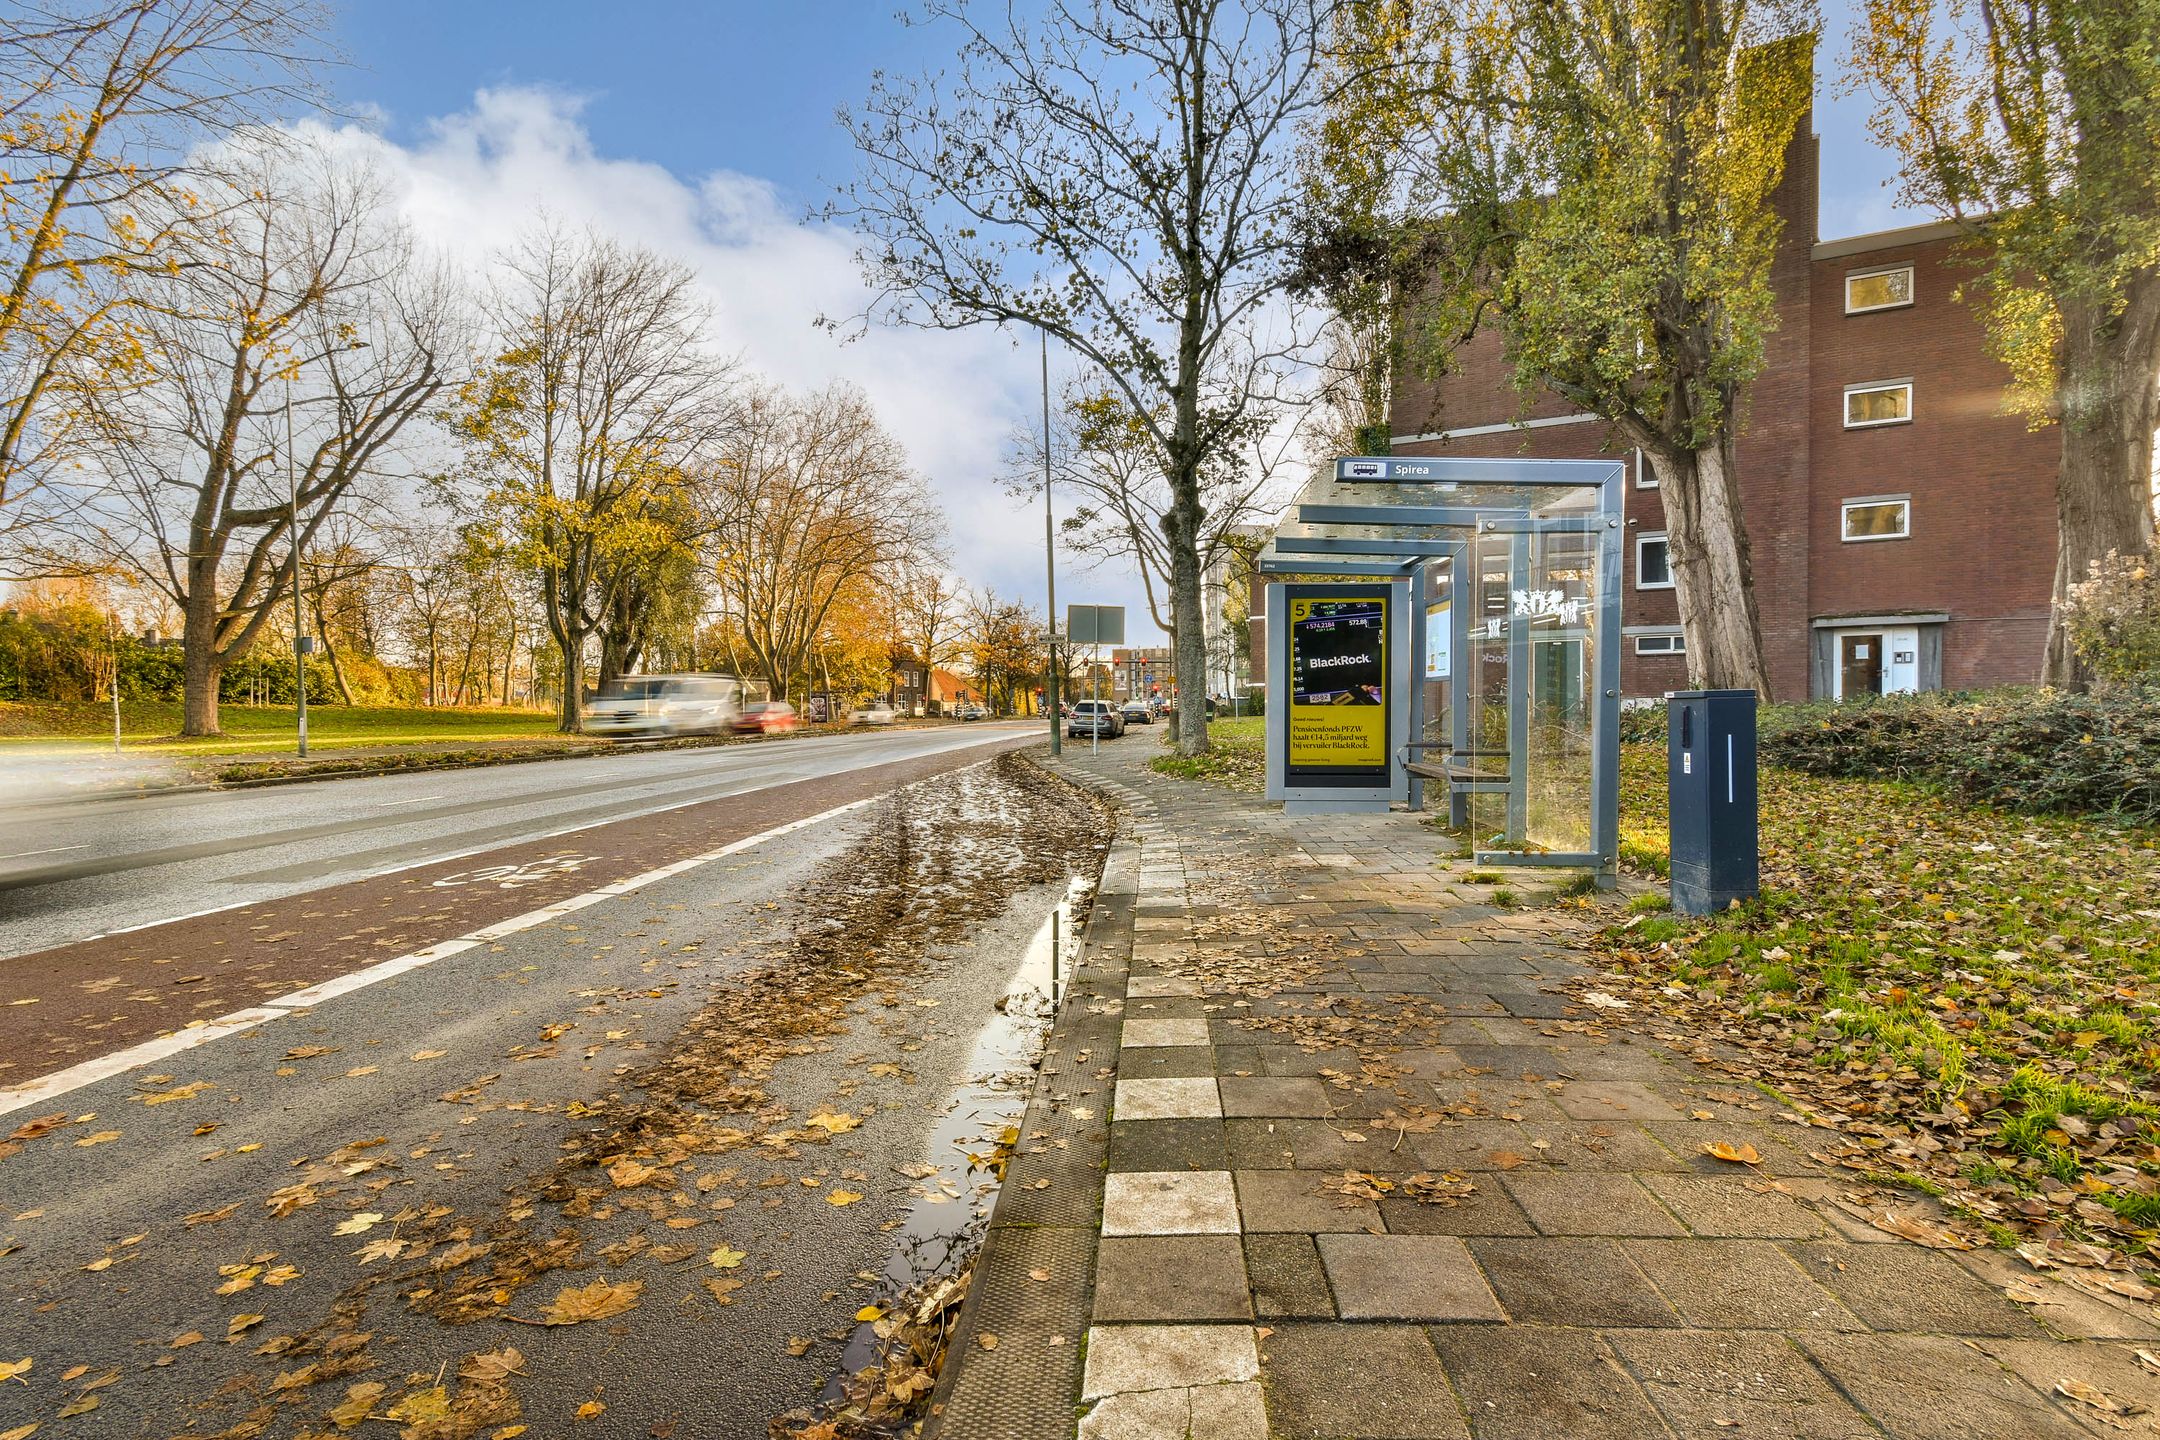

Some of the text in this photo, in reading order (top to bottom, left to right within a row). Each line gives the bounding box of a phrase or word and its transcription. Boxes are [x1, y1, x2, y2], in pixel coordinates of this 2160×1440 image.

[1395, 465, 1429, 476] Spirea
[1295, 604, 1305, 616] 5
[1309, 653, 1372, 669] BlackRock.
[1293, 725, 1363, 733] Pensioenfonds PFZW
[1310, 734, 1330, 742] €14,5
[1330, 734, 1354, 742] miljard
[1354, 735, 1368, 743] weg
[1293, 742, 1302, 750] bij
[1332, 741, 1370, 749] BlackRock.
